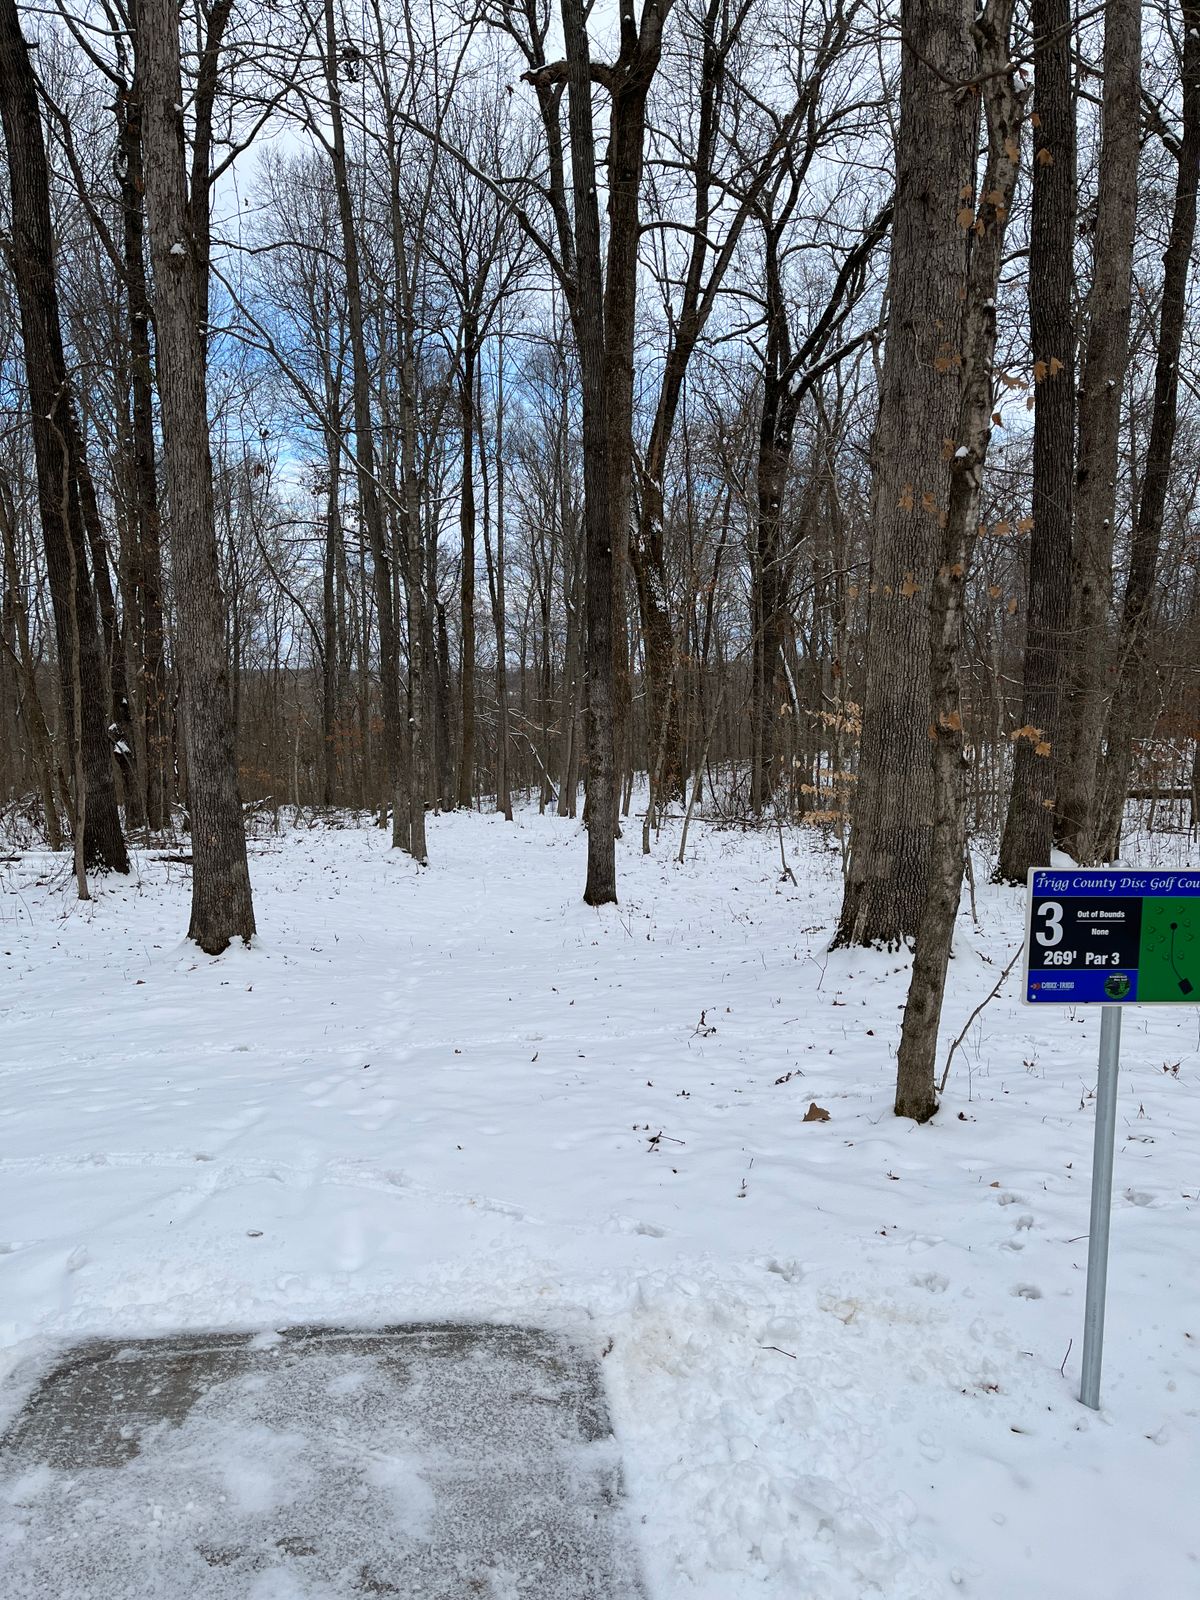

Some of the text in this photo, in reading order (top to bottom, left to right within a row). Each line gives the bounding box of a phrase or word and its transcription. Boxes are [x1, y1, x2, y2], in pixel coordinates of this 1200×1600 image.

[1036, 876, 1069, 891] Trigg
[1072, 878, 1117, 892] County
[1119, 877, 1147, 888] Disc
[1150, 876, 1178, 891] Golf
[1077, 910, 1126, 918] Out of Bounds
[1035, 901, 1064, 946] 3
[1091, 928, 1110, 936] None
[1043, 950, 1120, 966] 269' Par 3
